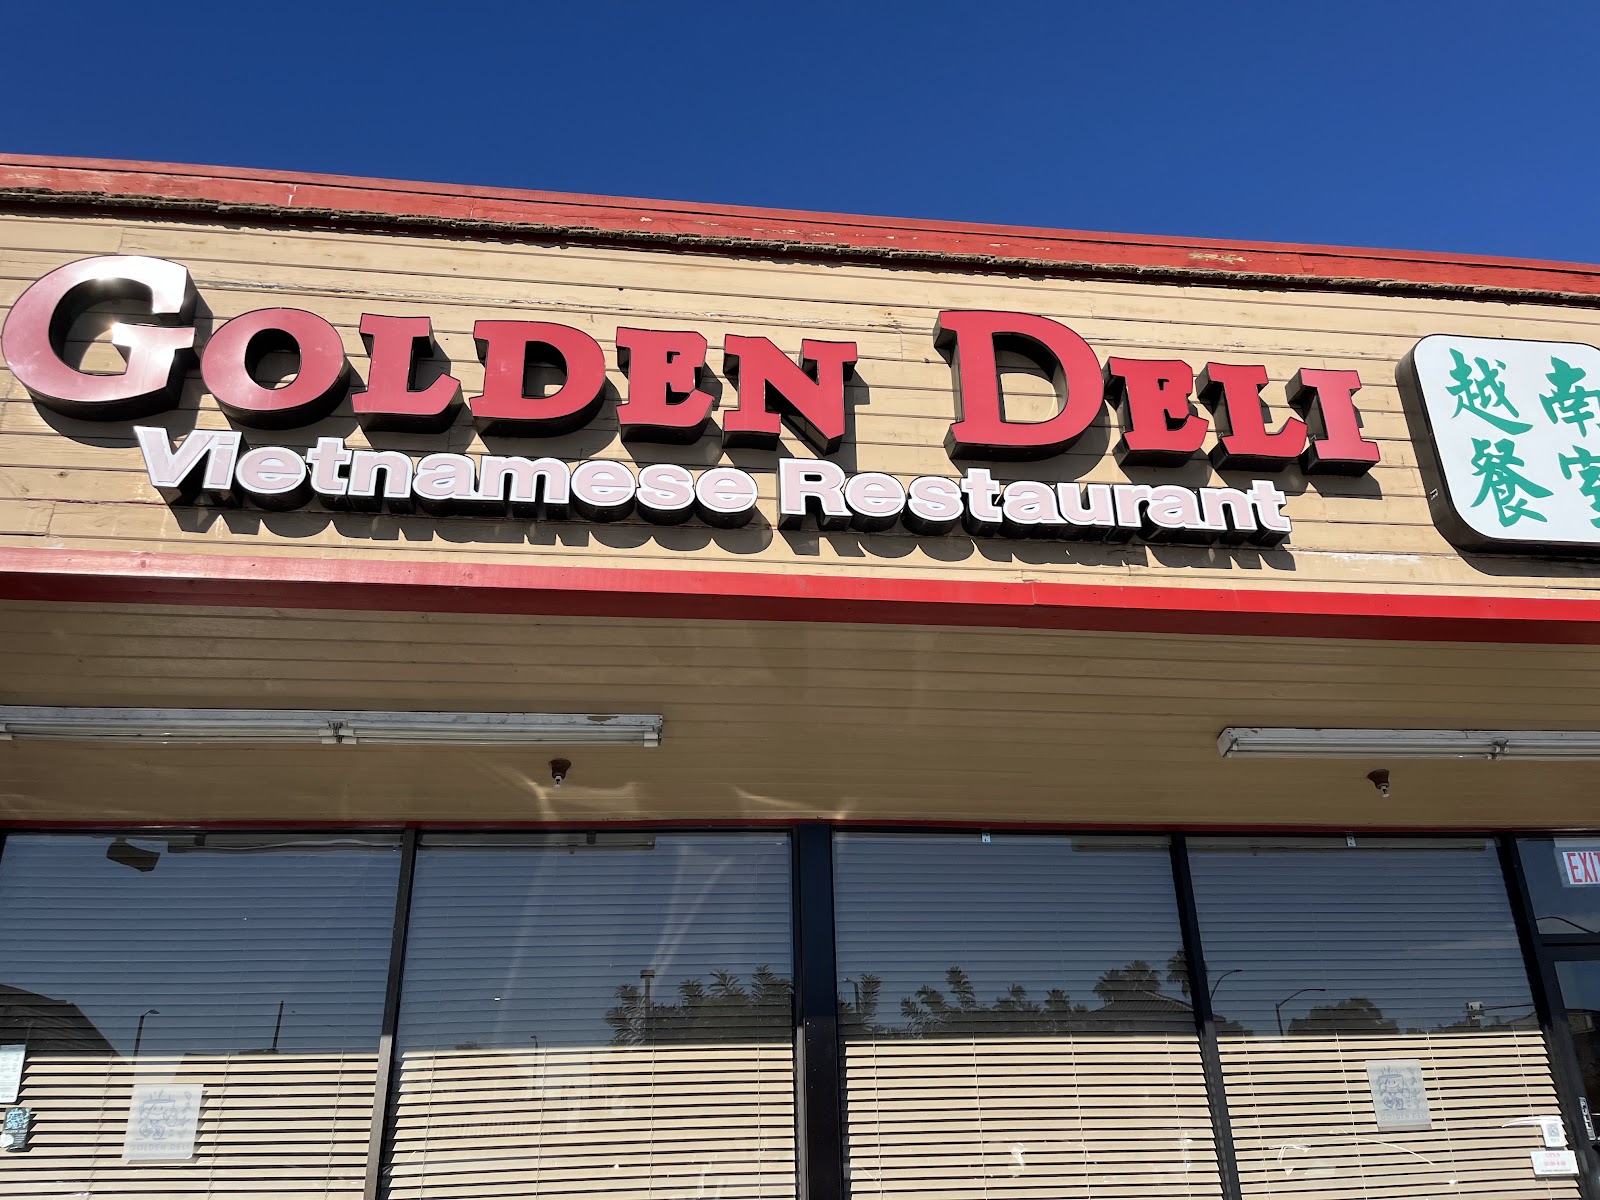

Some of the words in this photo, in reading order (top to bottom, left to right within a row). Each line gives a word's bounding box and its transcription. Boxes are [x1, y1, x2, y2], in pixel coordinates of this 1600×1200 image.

[1, 255, 858, 444] GOLDEN
[936, 309, 1380, 466] DELI
[133, 425, 759, 516] Vietnamese
[779, 457, 1292, 533] Restaurant
